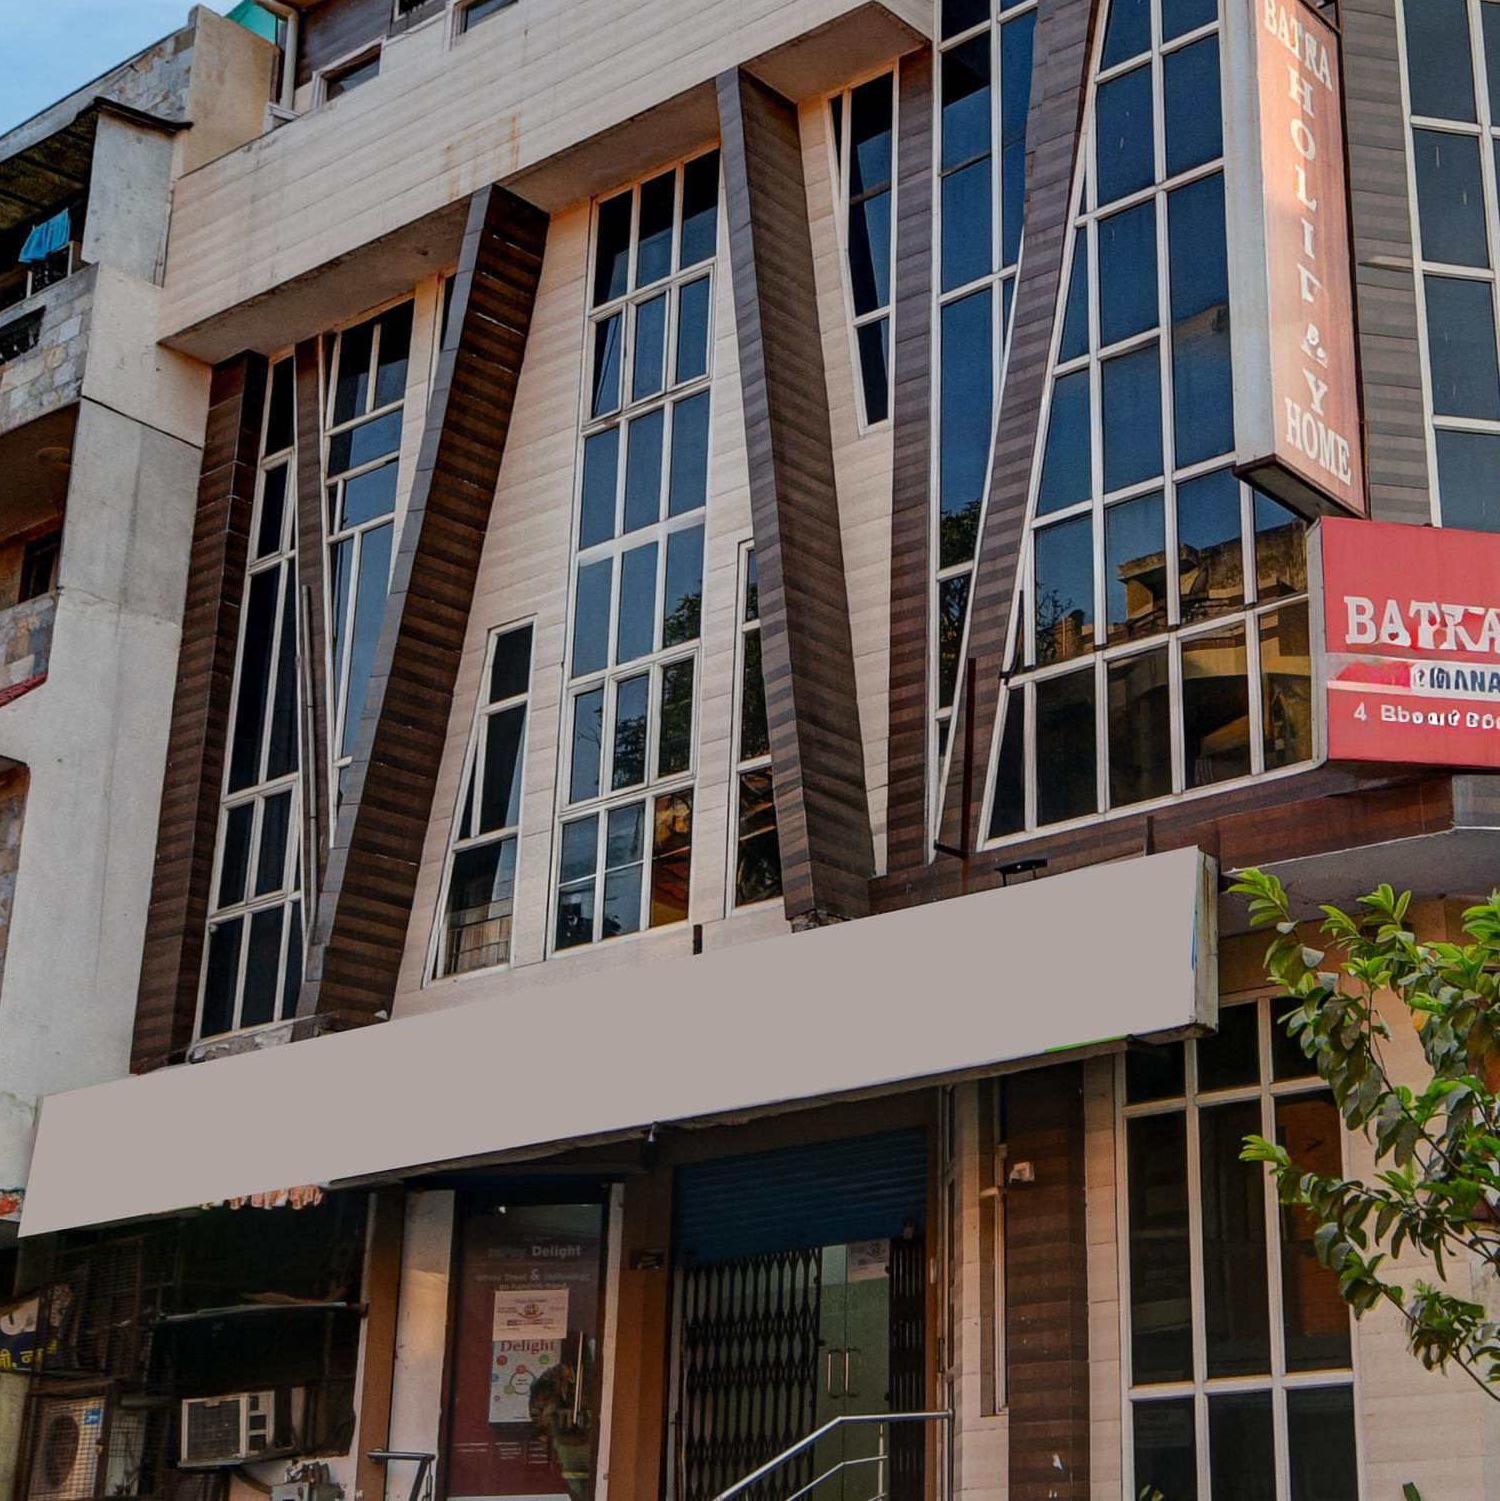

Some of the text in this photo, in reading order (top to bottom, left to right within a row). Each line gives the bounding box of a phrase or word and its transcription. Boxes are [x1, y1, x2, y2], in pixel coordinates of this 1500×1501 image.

[1284, 394, 1353, 487] HOME
[531, 1244, 583, 1259] Delight
[499, 1339, 557, 1355] Delight
